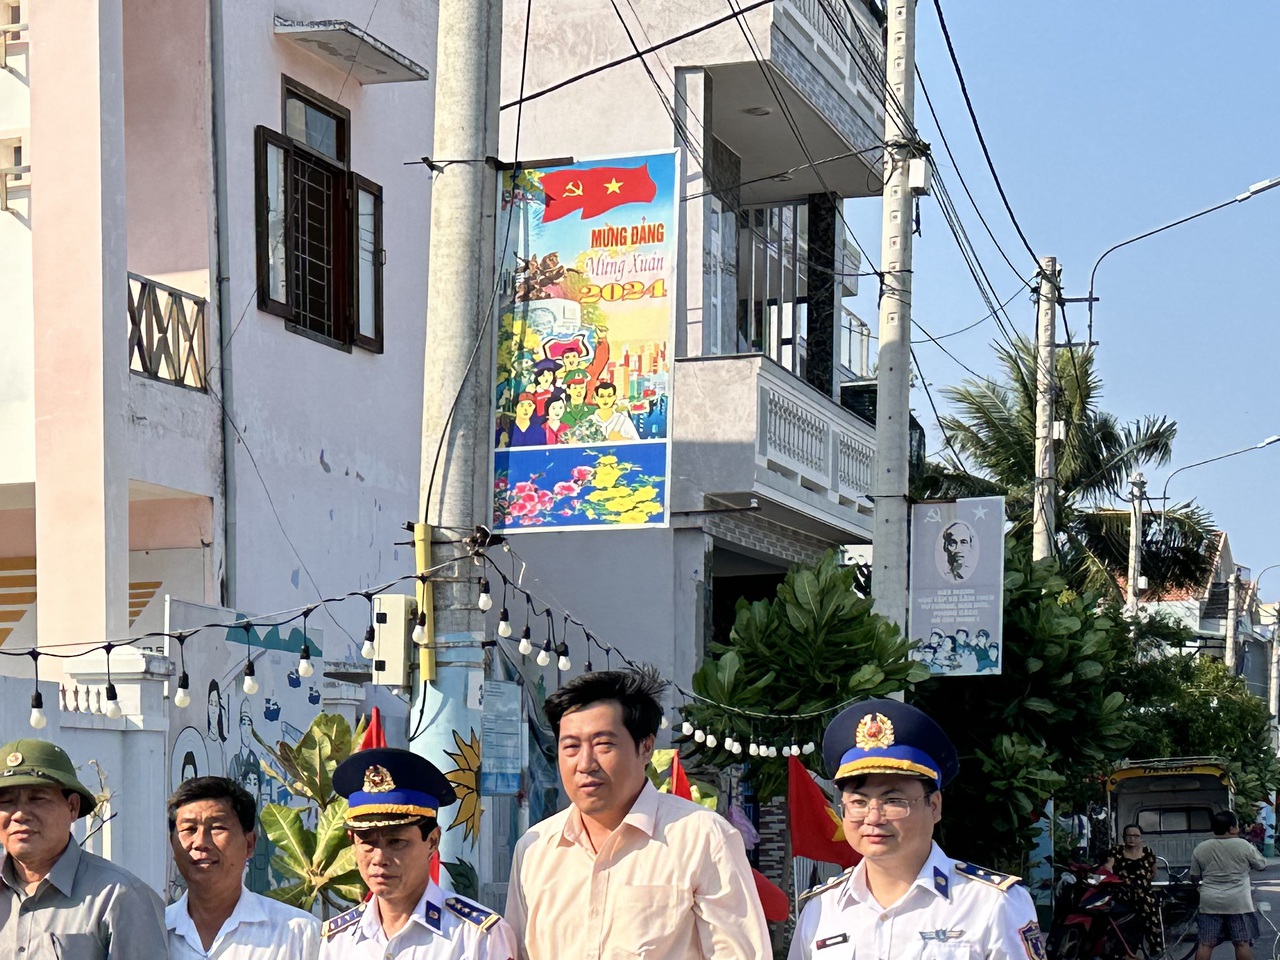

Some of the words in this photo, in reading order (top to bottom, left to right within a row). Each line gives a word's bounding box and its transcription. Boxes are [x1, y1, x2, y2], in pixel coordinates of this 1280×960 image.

[591, 222, 628, 248] MỪNG
[631, 216, 665, 245] ĐẢNG
[586, 253, 626, 282] Mừng
[628, 251, 664, 273] Xuân
[579, 278, 667, 303] 2024
